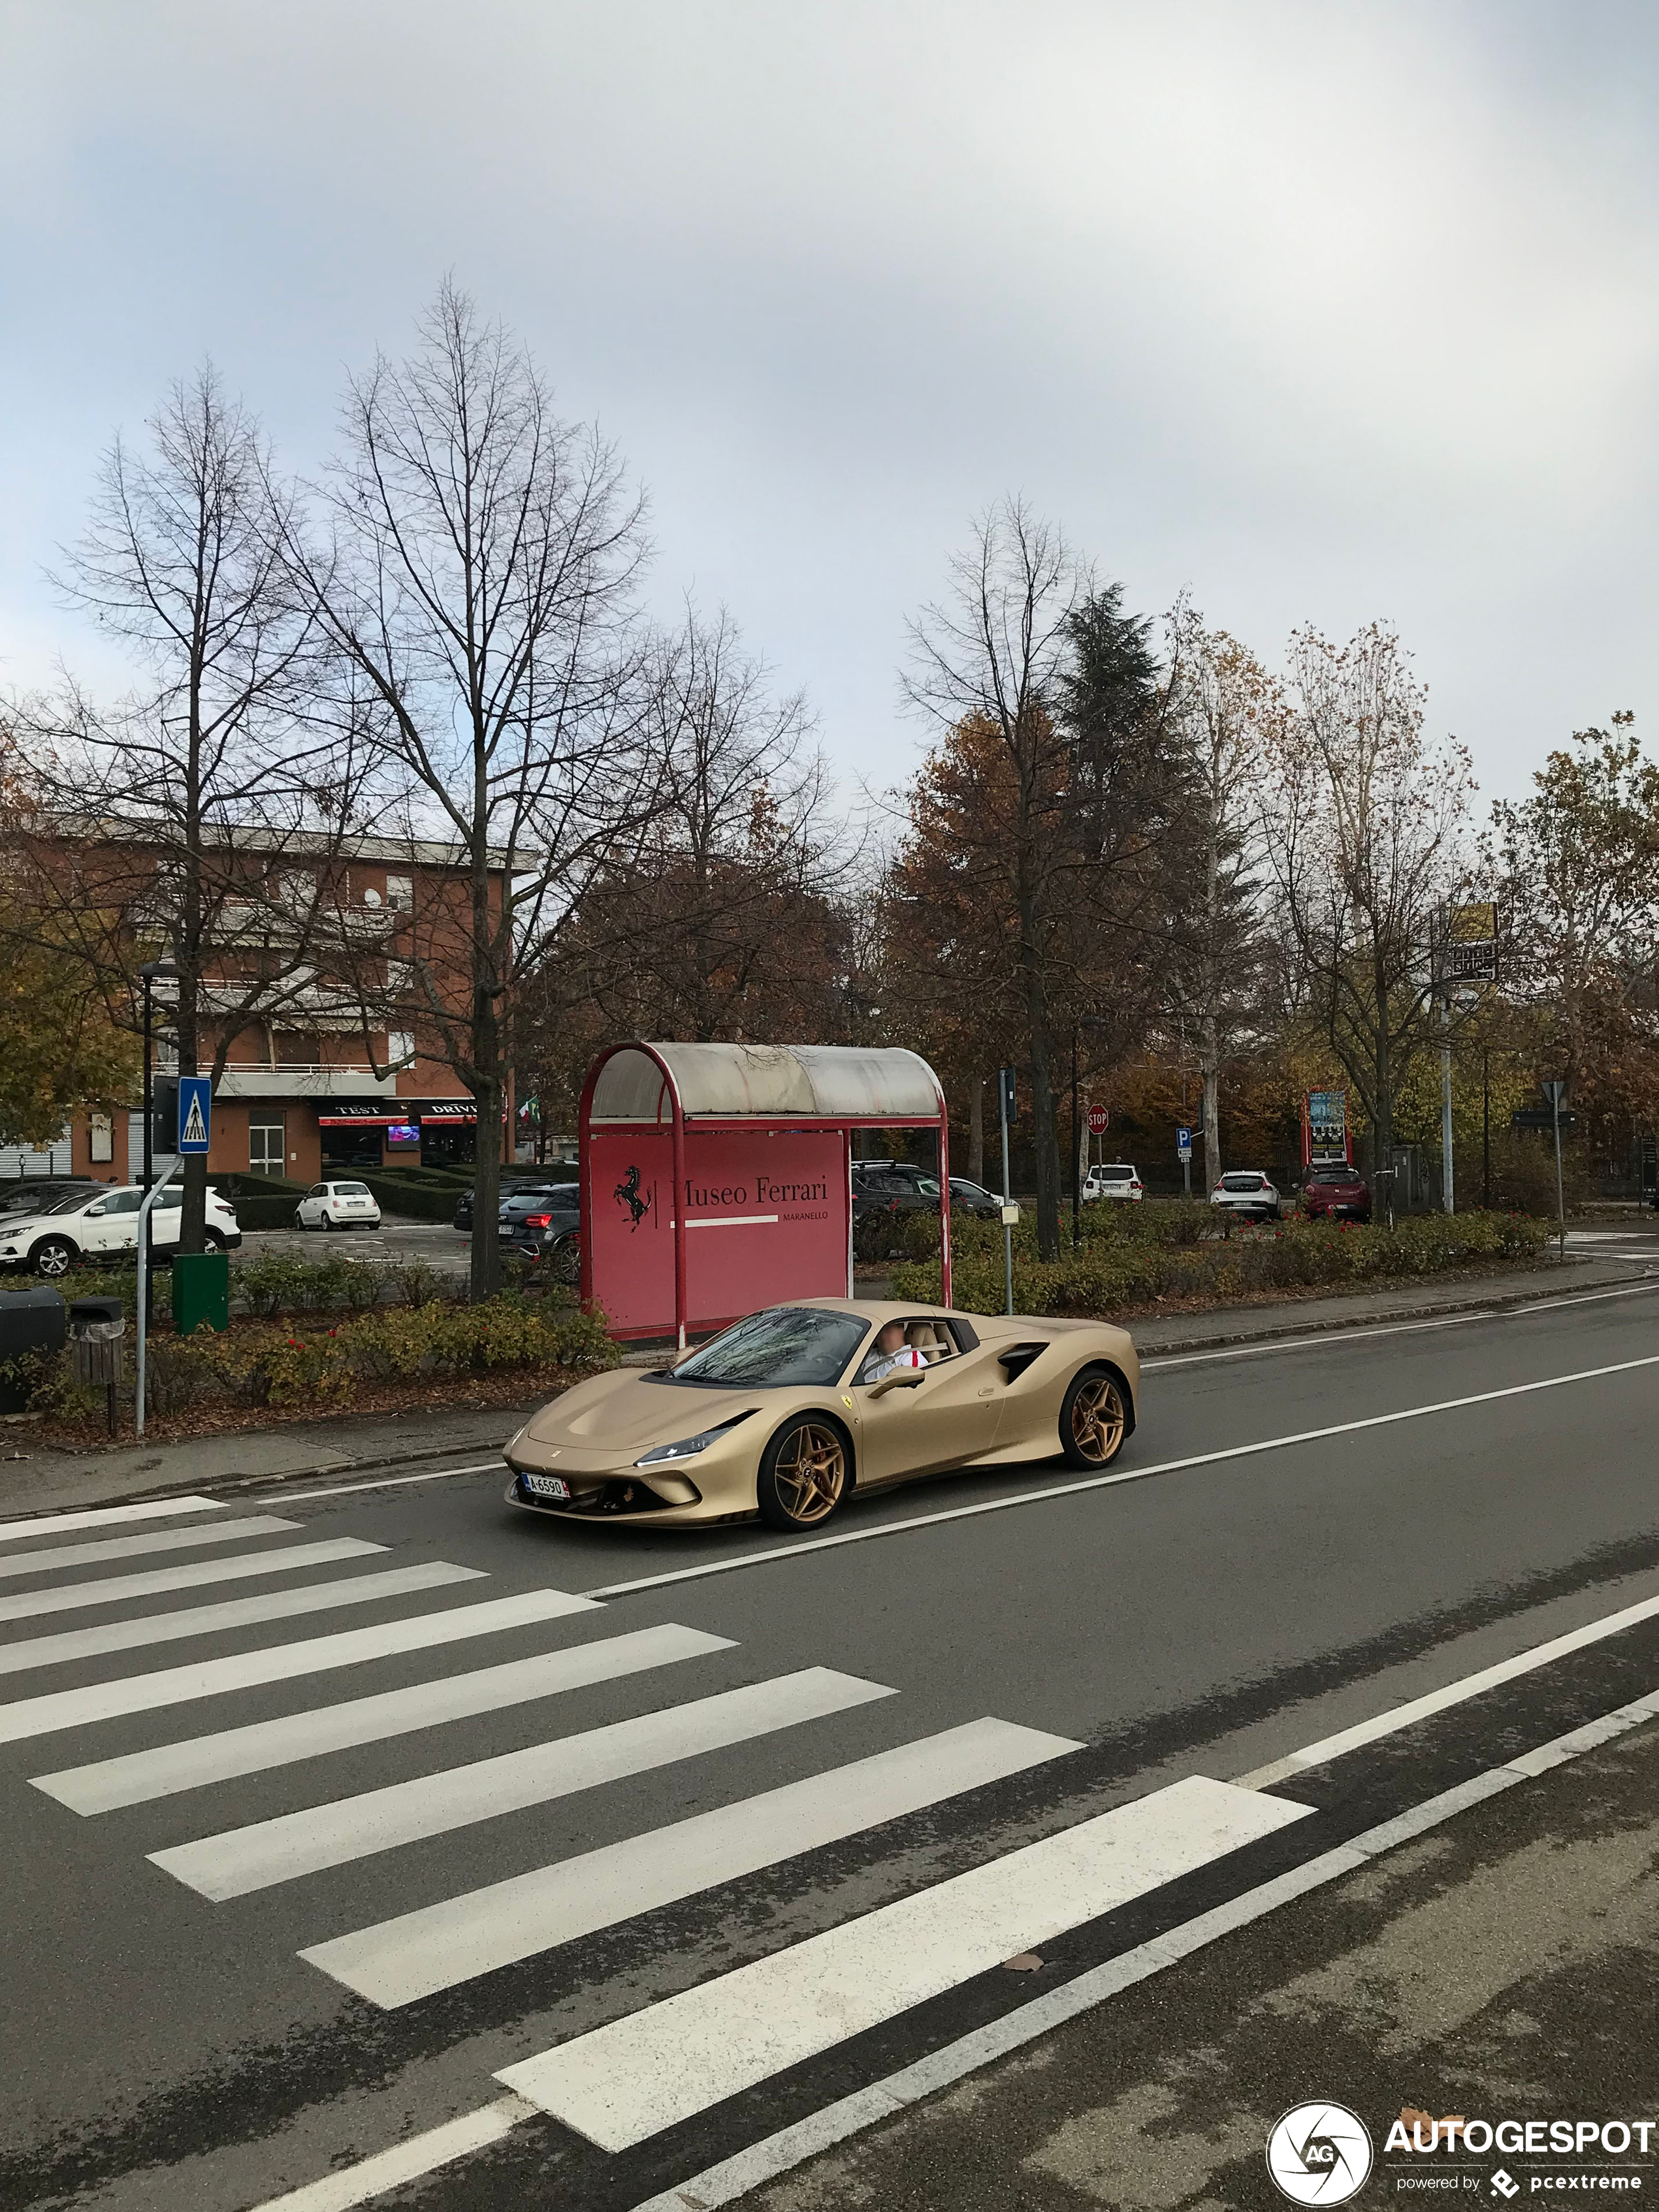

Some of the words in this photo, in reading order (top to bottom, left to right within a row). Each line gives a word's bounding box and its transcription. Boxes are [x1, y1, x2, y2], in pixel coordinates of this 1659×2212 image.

[1088, 1113, 1107, 1126] STOP
[1179, 1130, 1188, 1146] P
[755, 1175, 828, 1204] Ferrari
[783, 1211, 828, 1221] MARANELLO
